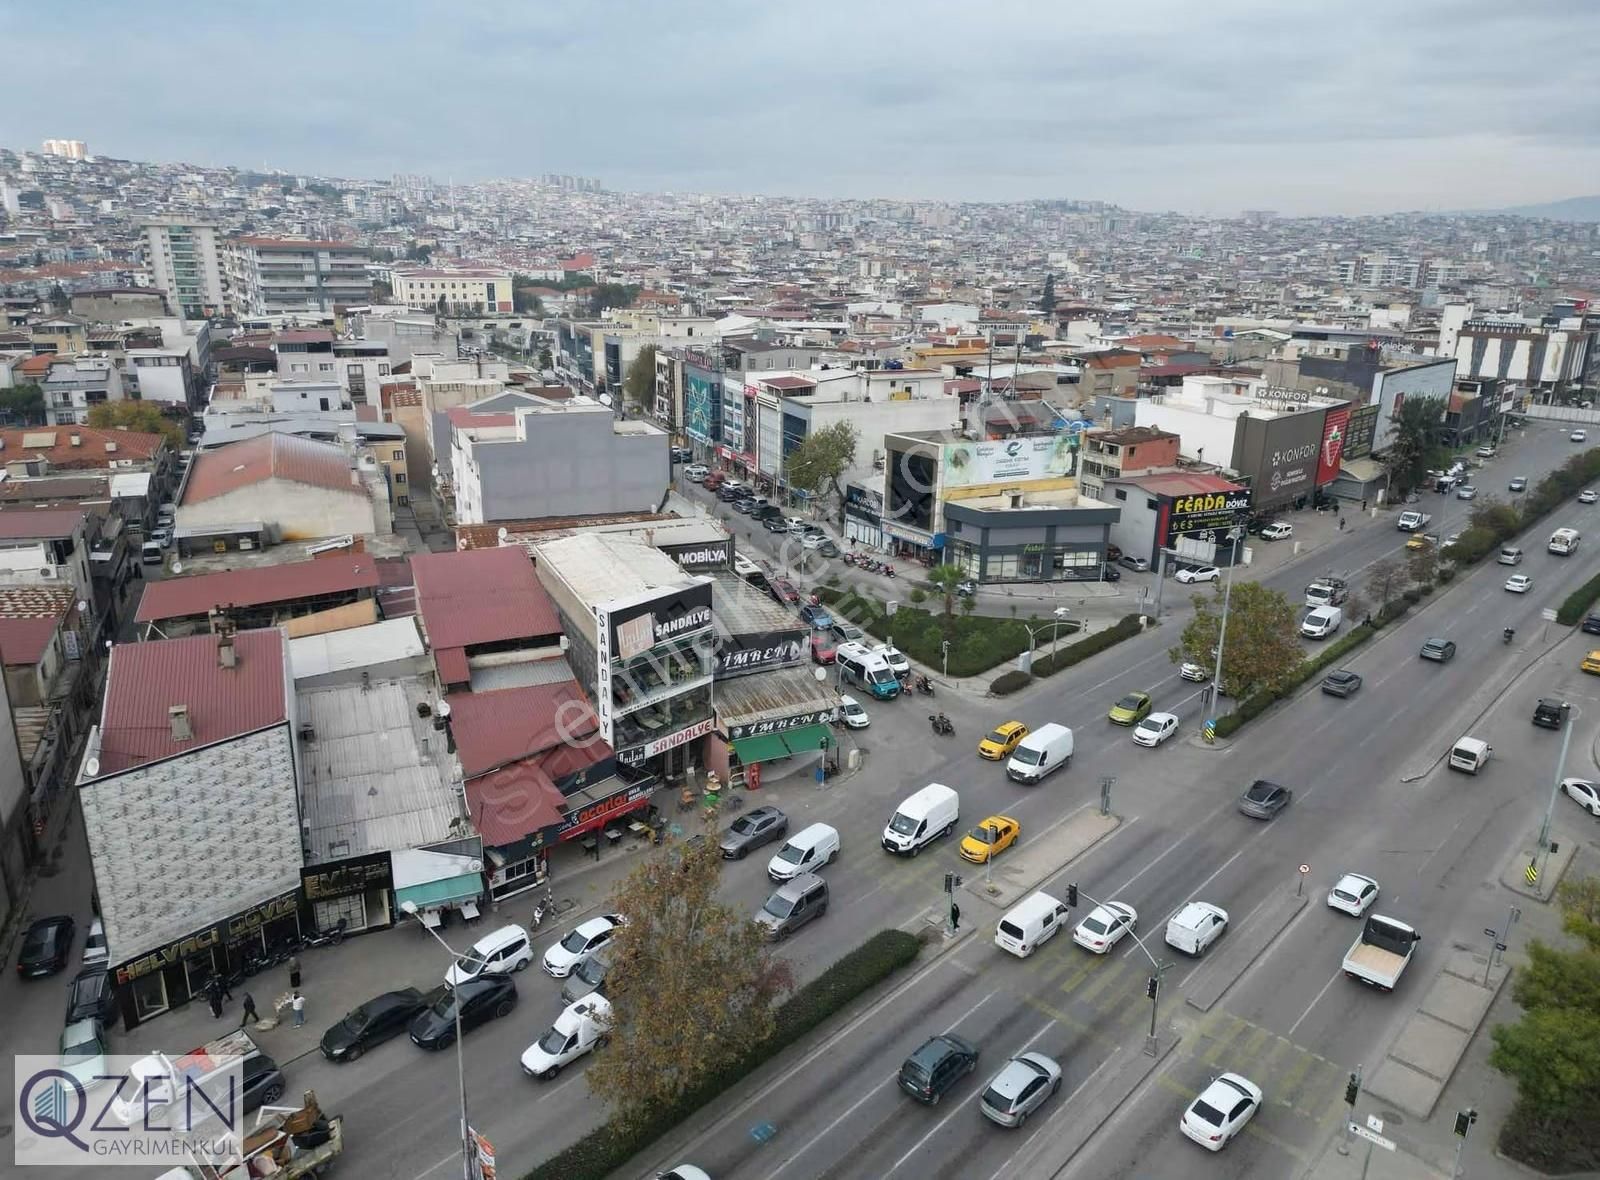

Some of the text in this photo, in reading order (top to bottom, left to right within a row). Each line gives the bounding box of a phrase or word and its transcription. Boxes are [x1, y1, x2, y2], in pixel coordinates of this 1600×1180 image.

[1268, 390, 1308, 401] KONFOR
[1282, 444, 1315, 464] KONFOR
[1176, 495, 1226, 513] FERDA
[679, 548, 726, 564] MOBİLYA
[655, 609, 710, 637] SANDALYE
[723, 644, 788, 667] İMREN
[598, 614, 609, 742] SANDALY
[652, 721, 711, 754] SANDALYE
